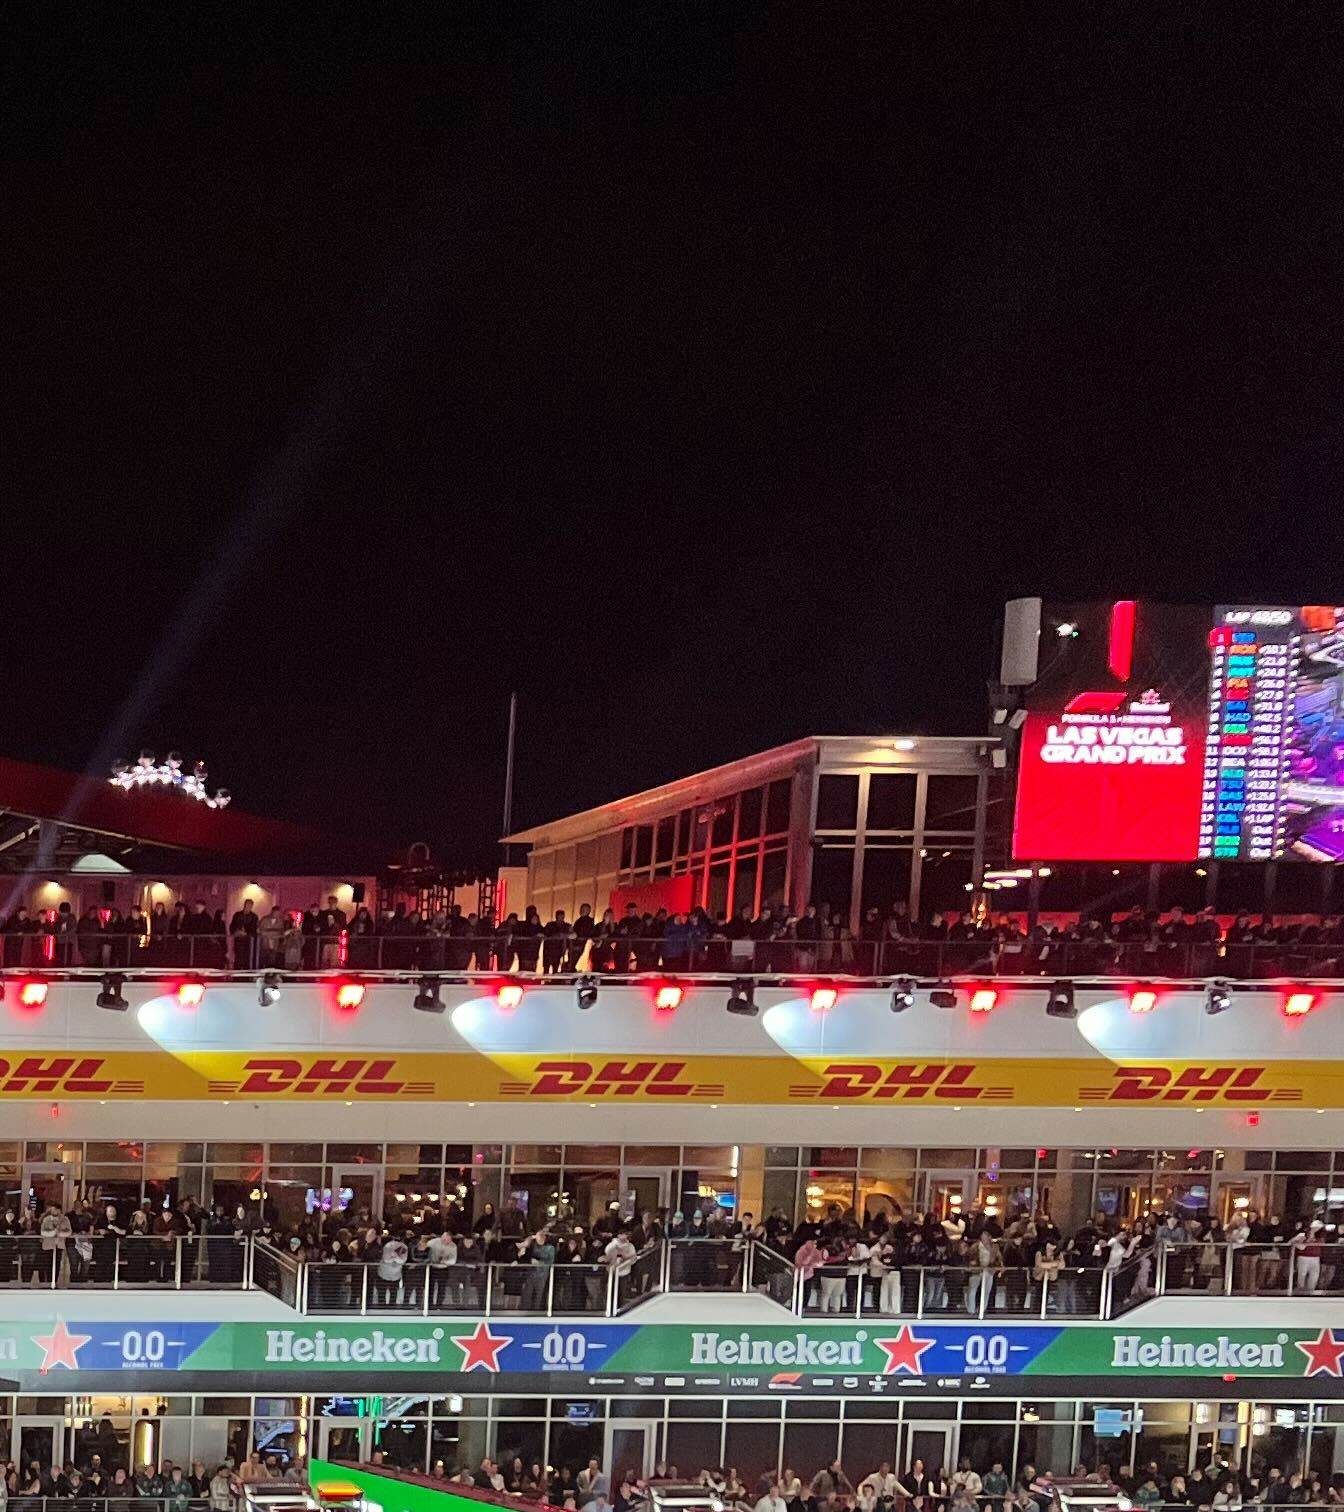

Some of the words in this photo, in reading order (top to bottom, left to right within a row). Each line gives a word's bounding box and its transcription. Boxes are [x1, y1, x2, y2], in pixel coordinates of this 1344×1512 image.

[1047, 725, 1098, 744] LAS
[1099, 727, 1183, 745] VEGAS
[1040, 744, 1127, 763] GRAND
[1127, 746, 1187, 764] PRIX
[238, 1060, 406, 1094] DHL
[531, 1062, 695, 1096] DHL
[819, 1065, 984, 1098] DHL
[1112, 1067, 1272, 1101] DHL
[123, 1331, 165, 1361] 0.0
[543, 1332, 586, 1363] 0.0
[964, 1335, 1008, 1366] 0.0
